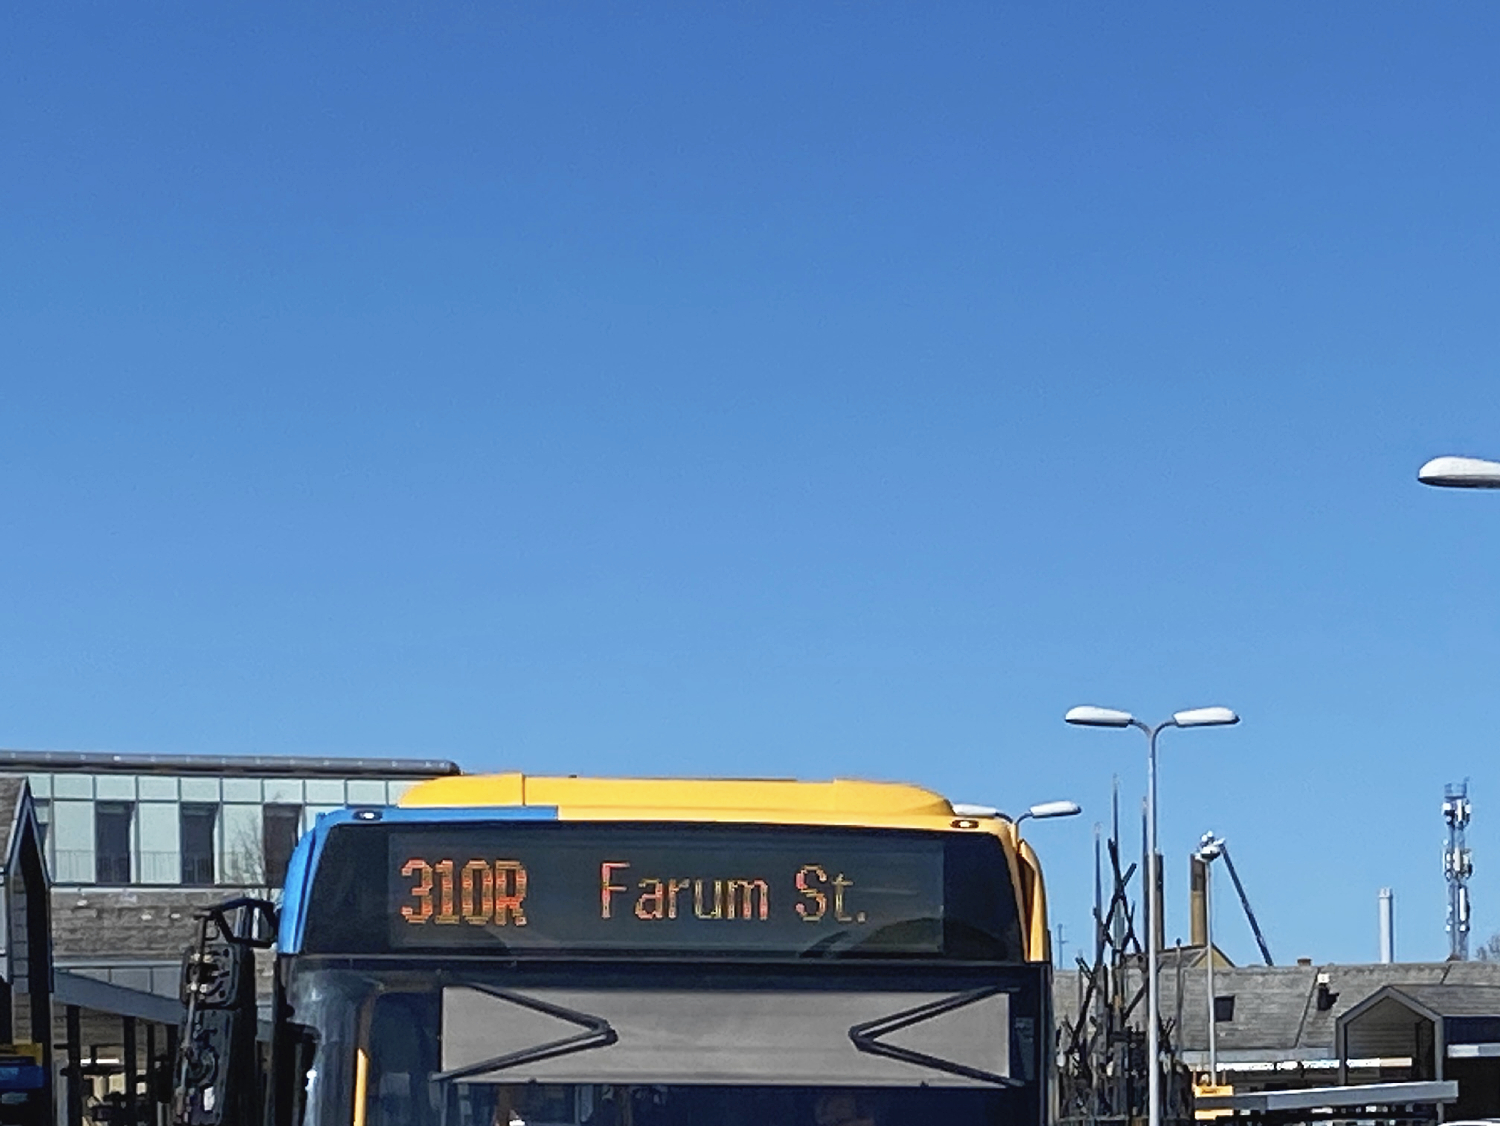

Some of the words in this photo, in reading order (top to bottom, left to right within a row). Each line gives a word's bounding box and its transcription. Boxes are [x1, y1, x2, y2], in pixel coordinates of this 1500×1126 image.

[401, 858, 528, 926] 310R
[601, 861, 769, 921] Farum
[795, 863, 867, 923] St.
